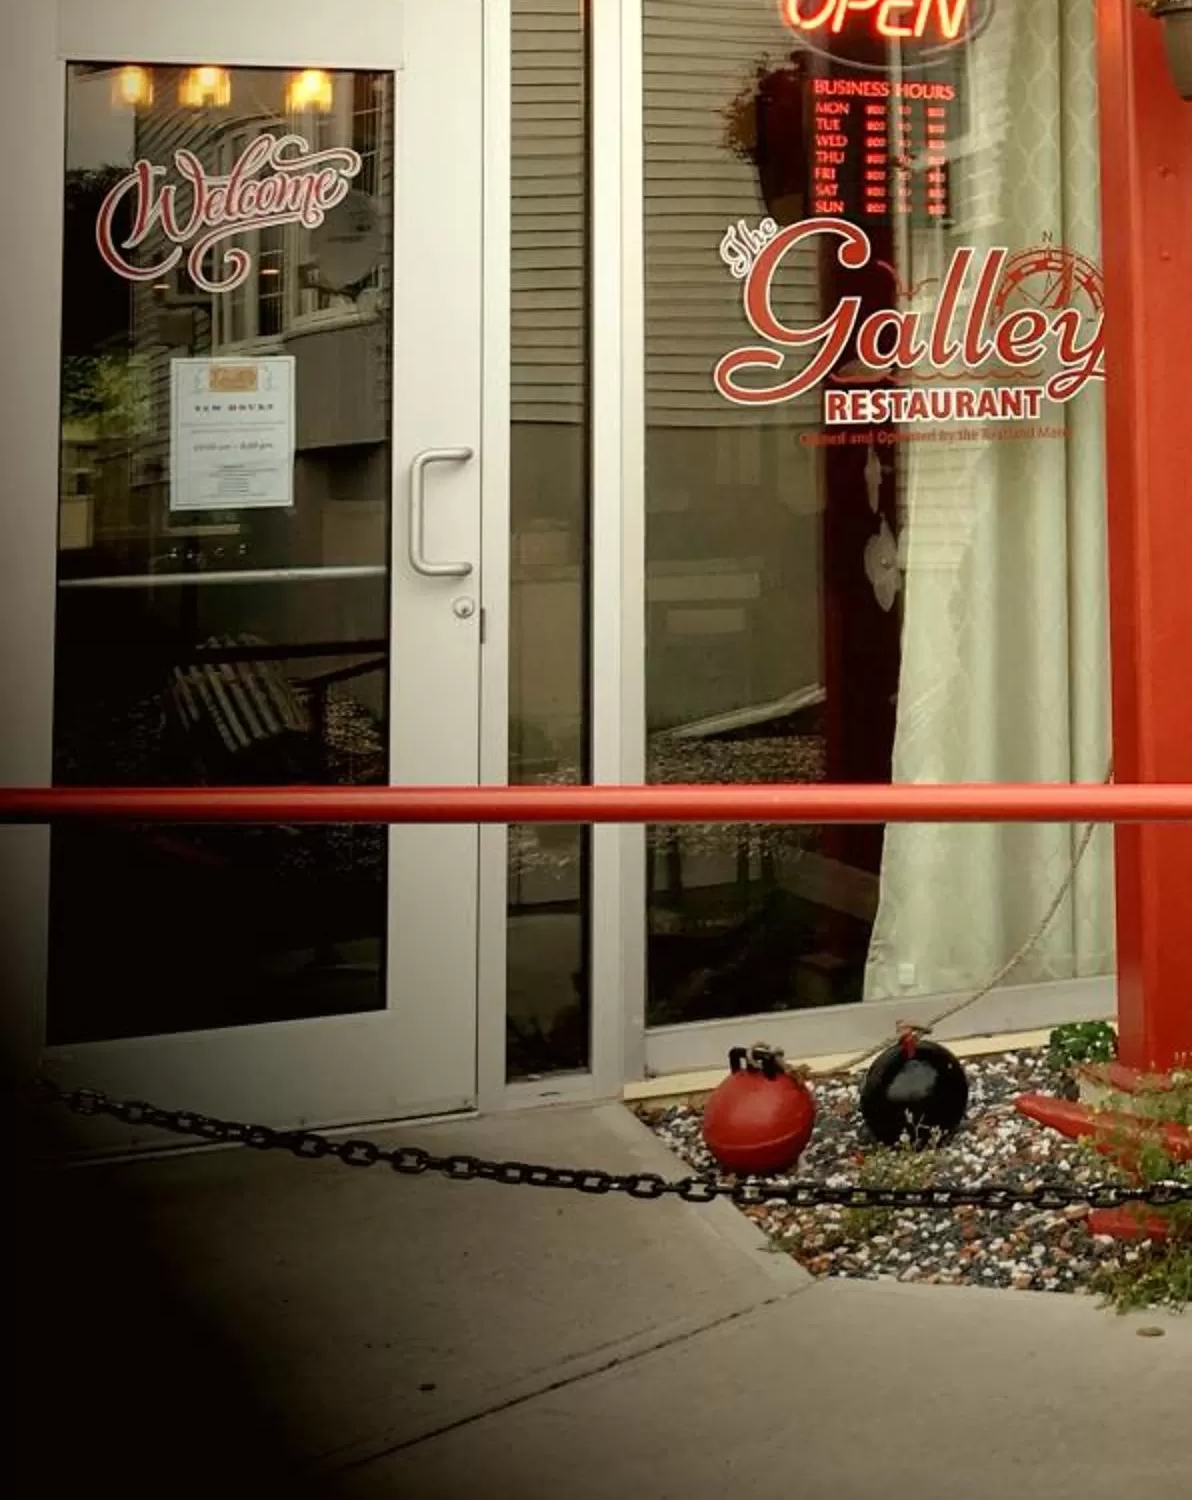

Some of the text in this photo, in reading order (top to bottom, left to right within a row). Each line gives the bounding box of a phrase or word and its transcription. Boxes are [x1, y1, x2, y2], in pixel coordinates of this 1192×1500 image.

[814, 79, 955, 100] BUSINESS HOURS
[815, 102, 849, 115] MON
[815, 117, 841, 131] TUE
[815, 134, 848, 148] WED
[815, 150, 845, 165] THU
[815, 167, 836, 180] FRI
[815, 183, 838, 197] SAT
[96, 133, 361, 293] Welcome
[815, 200, 845, 213] SUN
[719, 216, 777, 279] The
[713, 218, 1107, 404] Galley
[825, 386, 1045, 425] RESTAURANT
